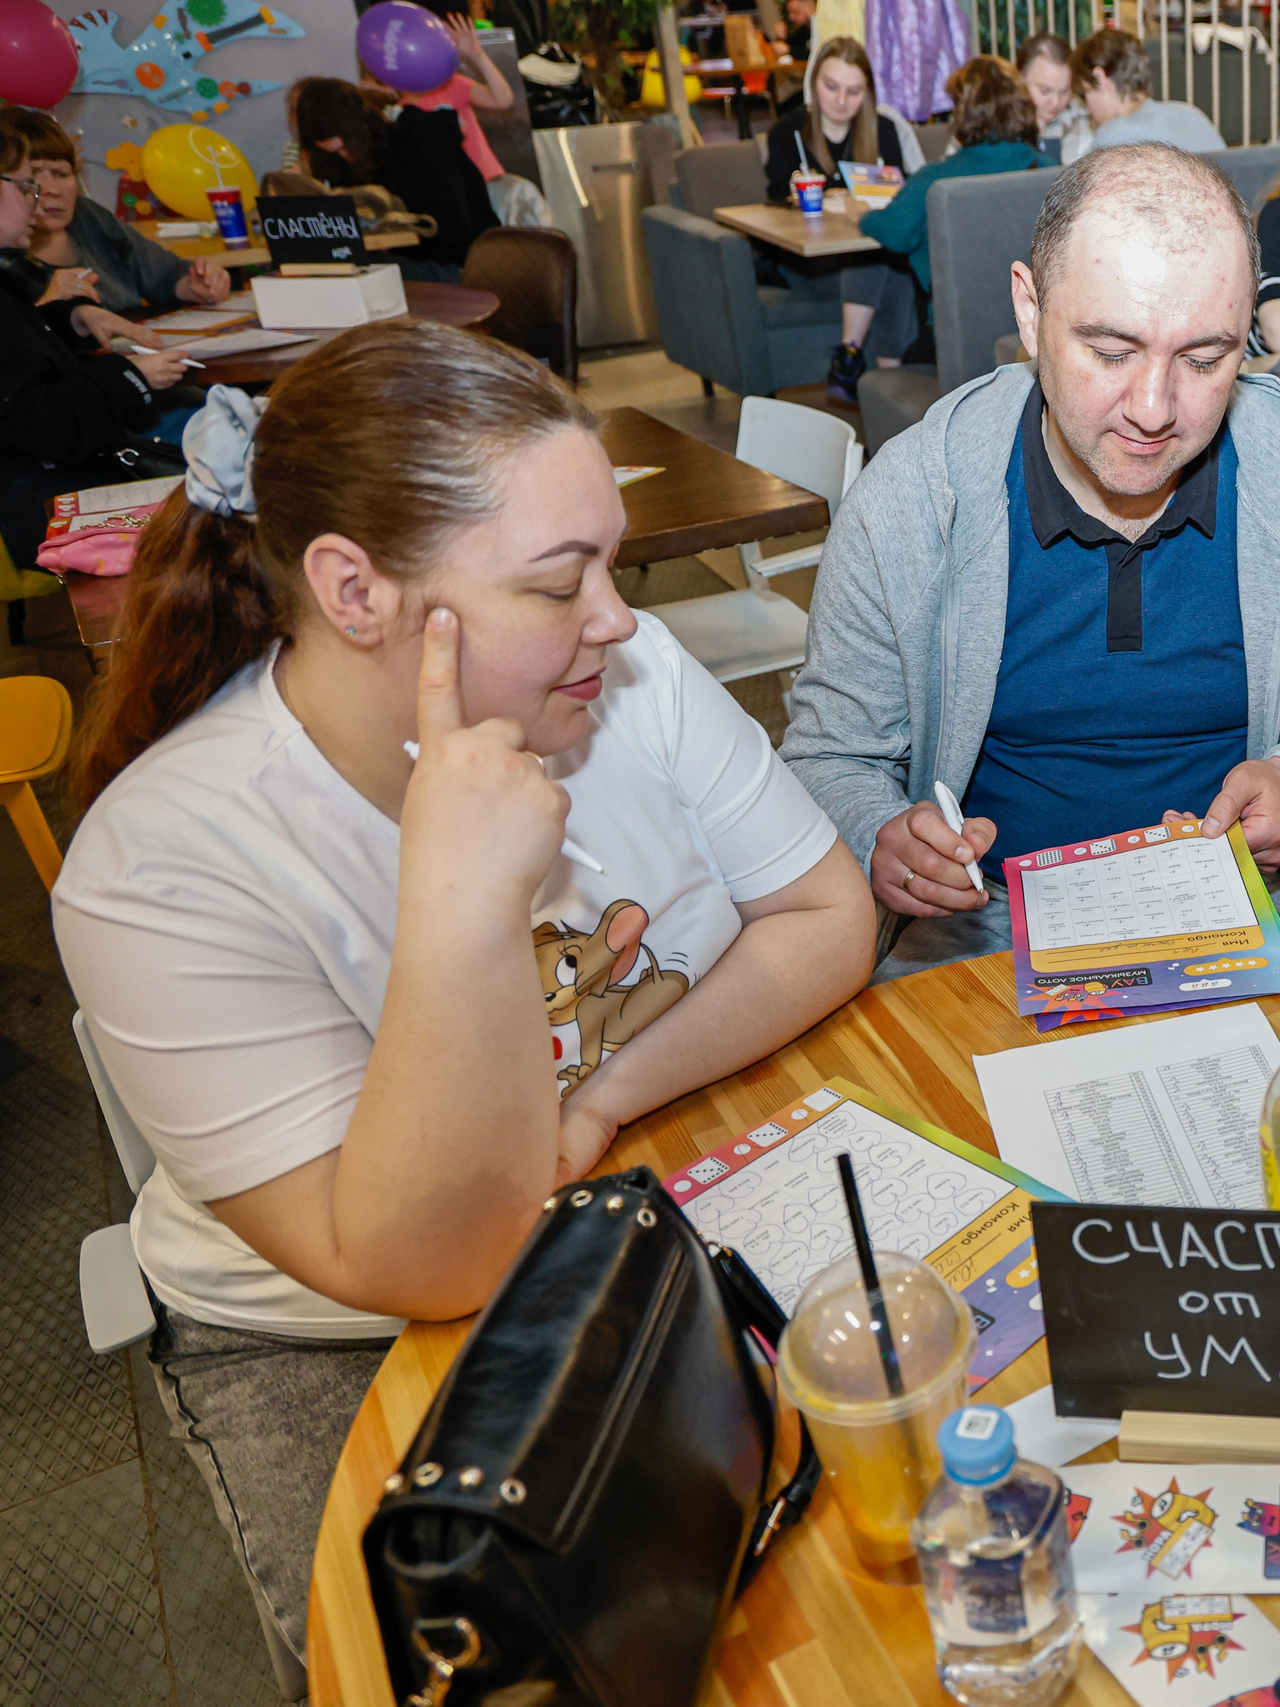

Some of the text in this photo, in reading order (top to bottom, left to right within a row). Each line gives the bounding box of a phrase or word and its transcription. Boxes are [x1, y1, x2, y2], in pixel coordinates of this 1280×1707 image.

[264, 211, 360, 240] СЛАСТЁНЫ
[1187, 931, 1246, 942] Команда
[1222, 939, 1250, 947] Имя
[1037, 969, 1147, 986] МУЗЫКАЛЬНОЕ ЛОТО
[1112, 977, 1149, 988] ВАУ
[960, 1202, 1020, 1246] Команда
